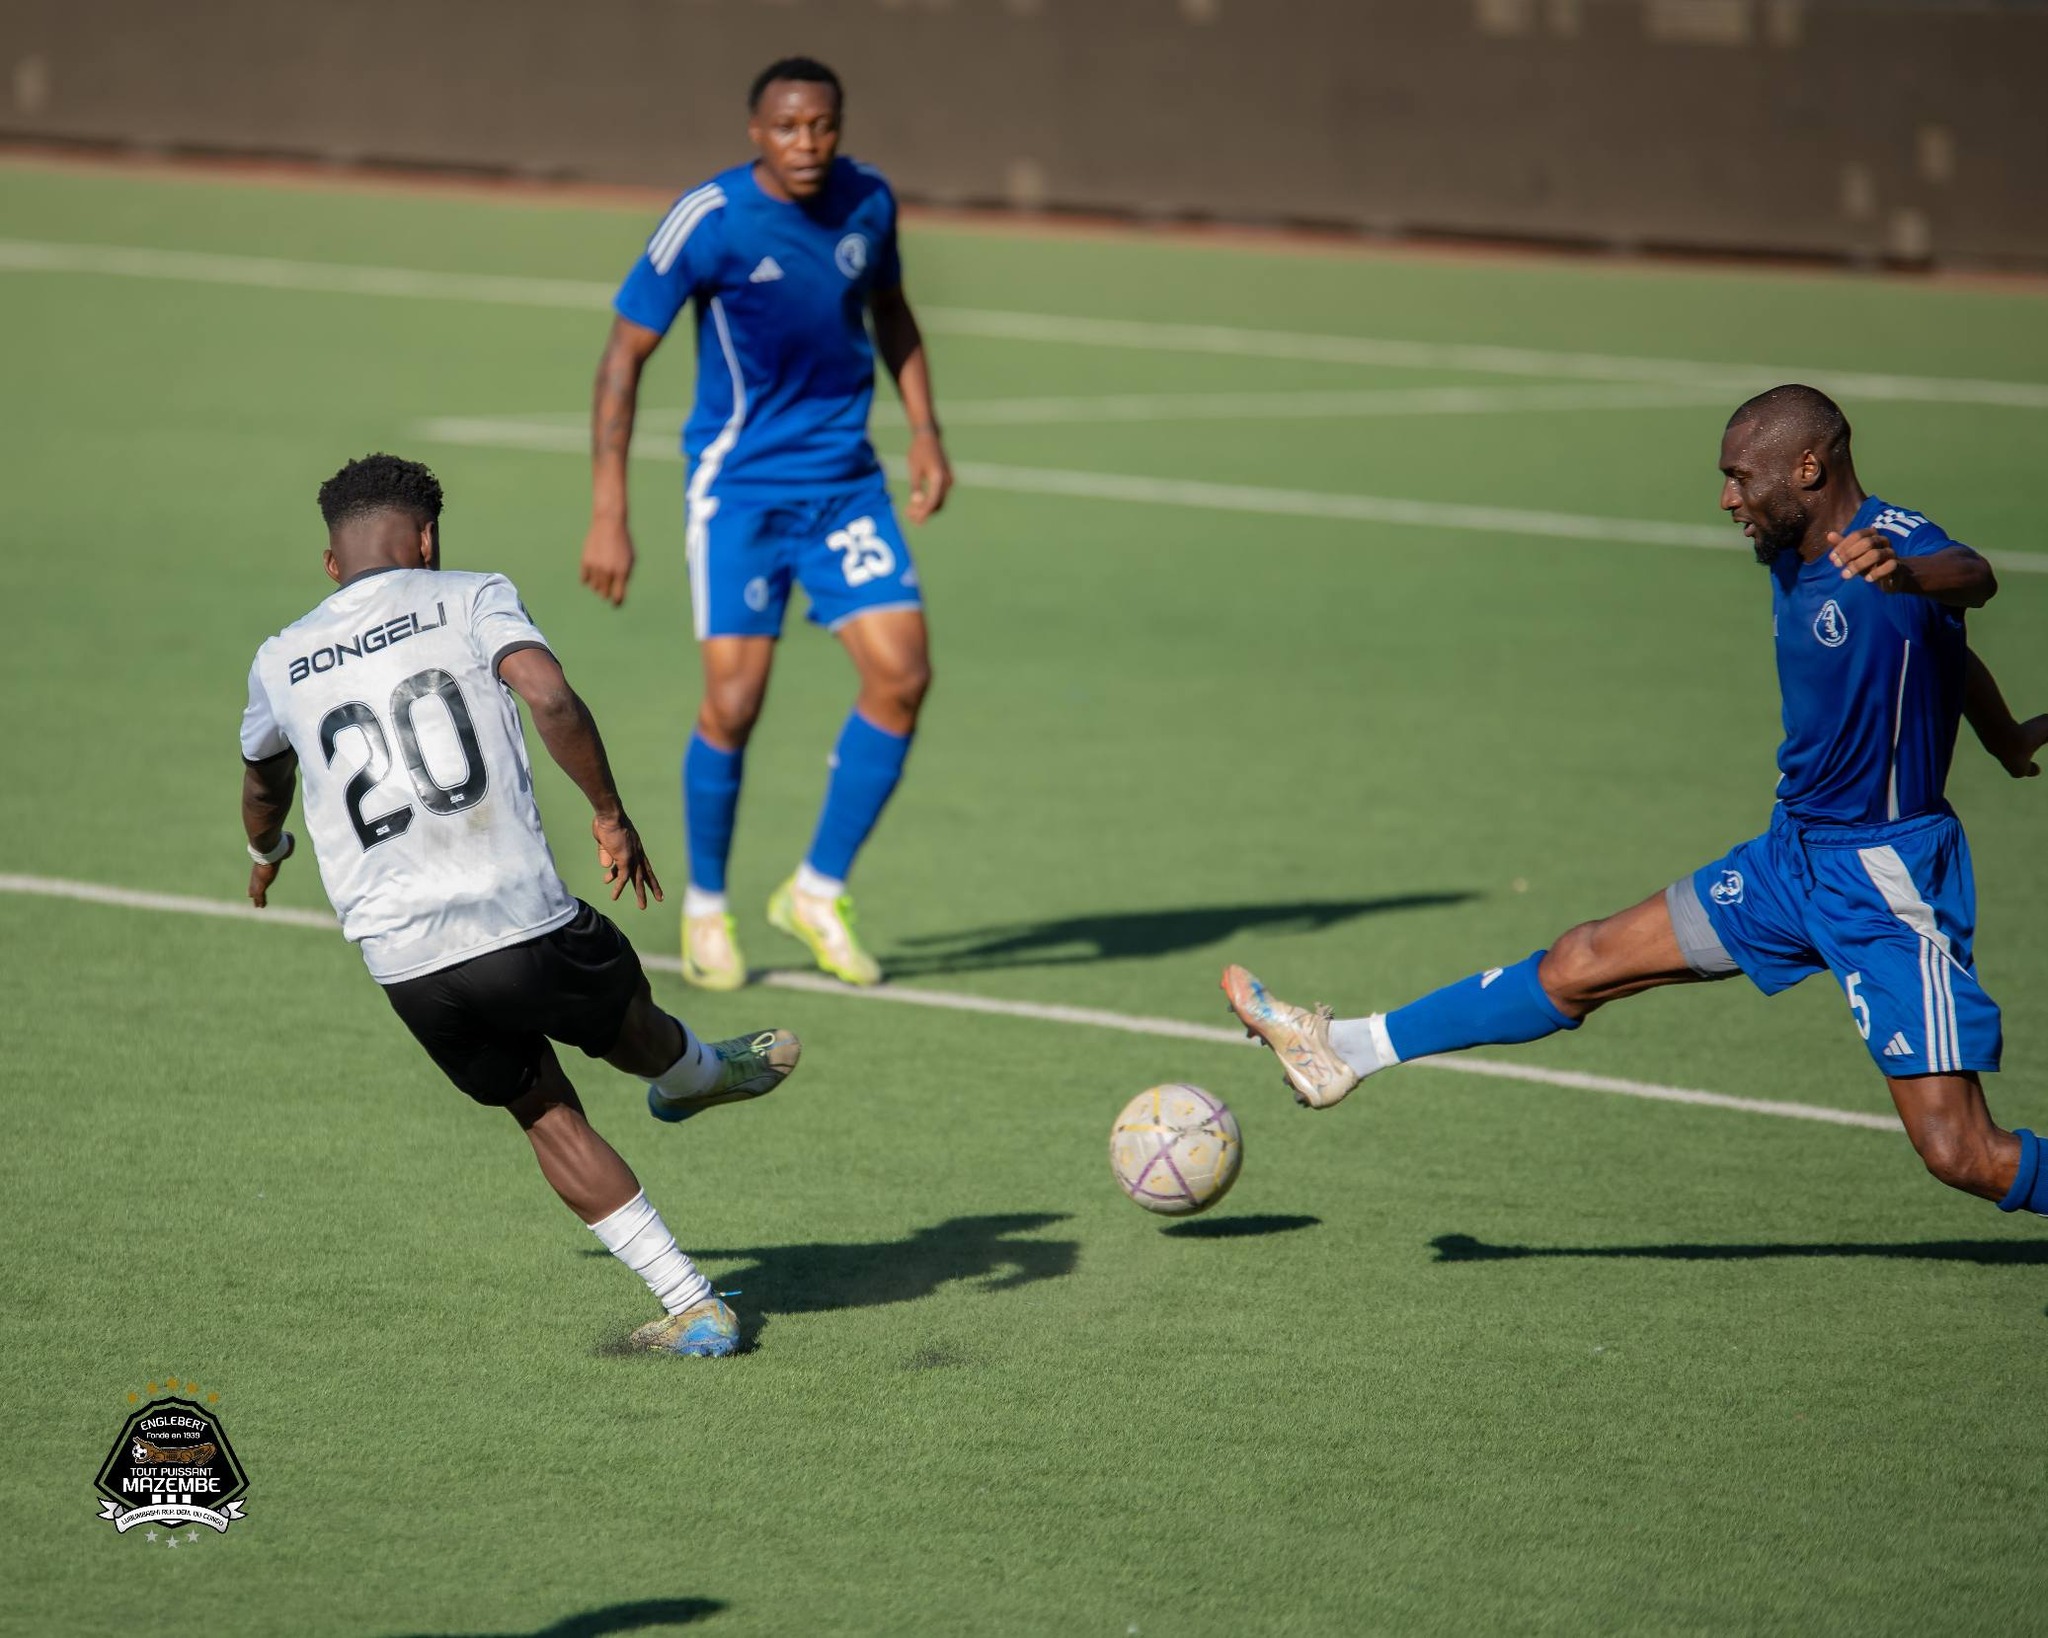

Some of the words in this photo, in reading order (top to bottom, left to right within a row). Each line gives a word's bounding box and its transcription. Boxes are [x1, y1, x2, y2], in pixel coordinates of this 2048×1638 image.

[288, 601, 447, 685] BONGELI
[317, 668, 489, 852] 20
[1846, 971, 1870, 1040] 5
